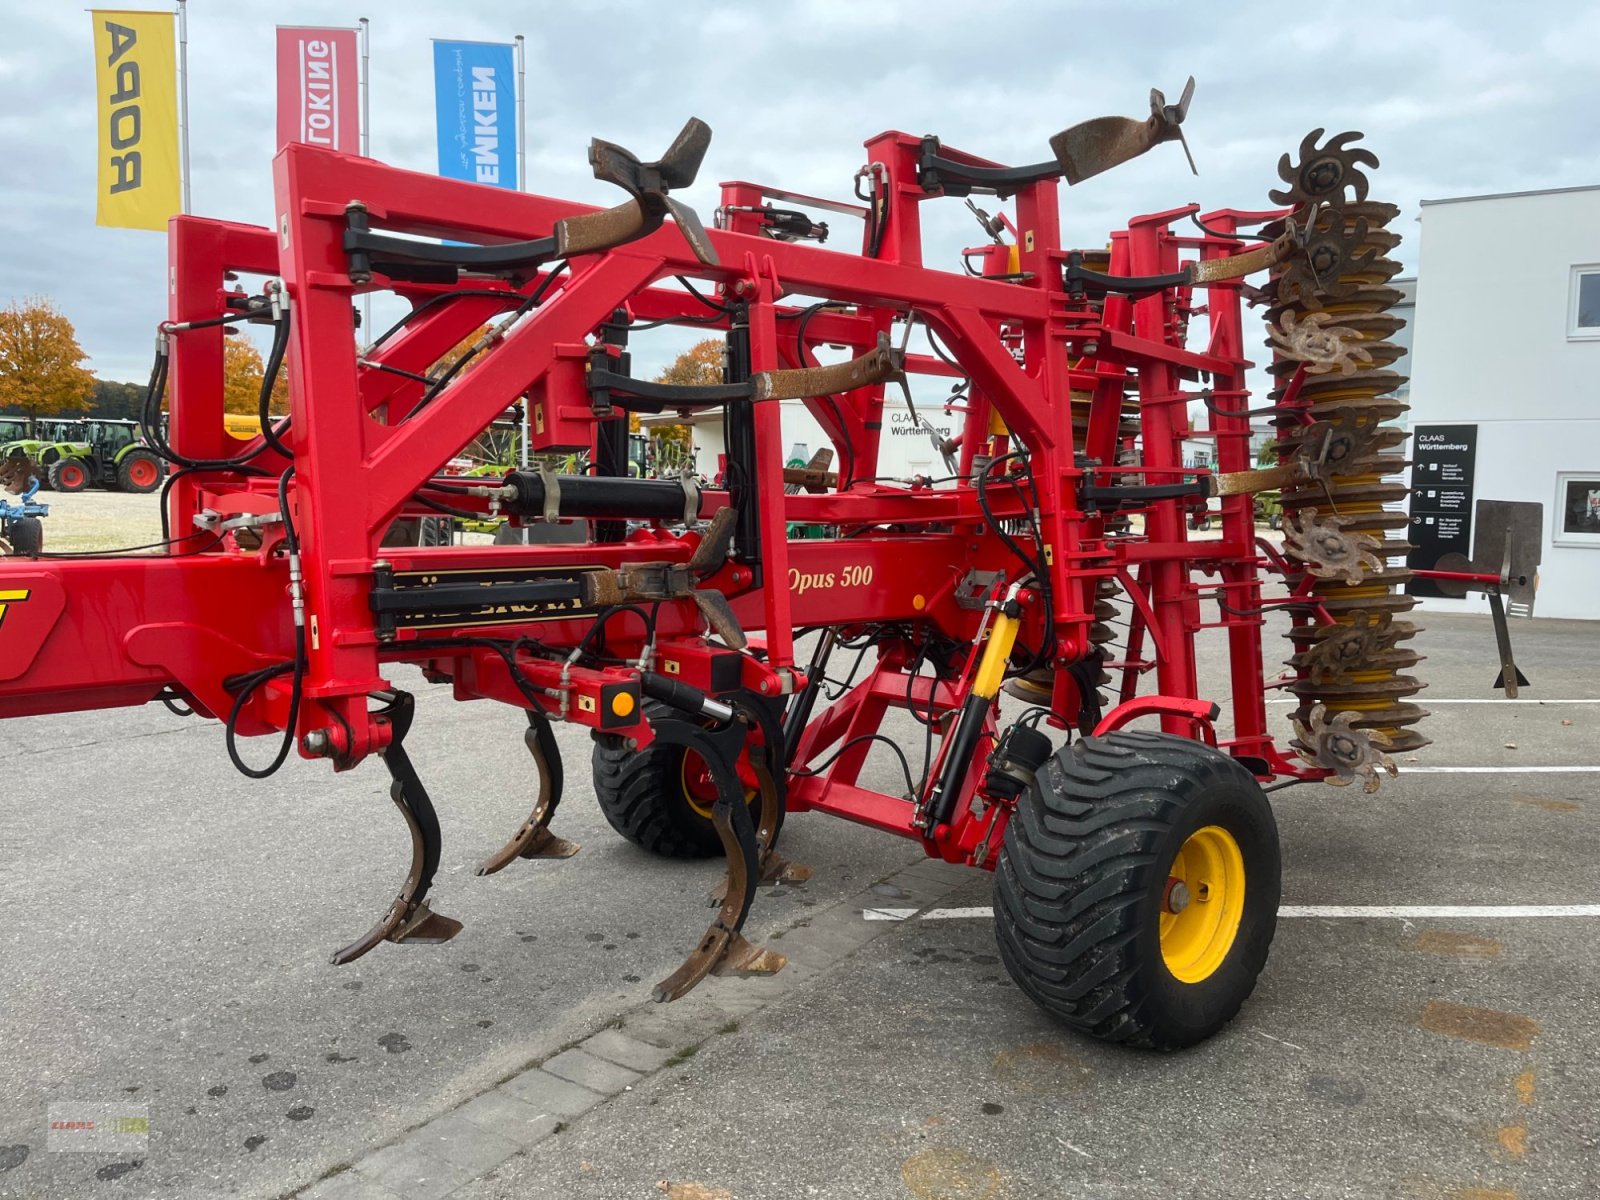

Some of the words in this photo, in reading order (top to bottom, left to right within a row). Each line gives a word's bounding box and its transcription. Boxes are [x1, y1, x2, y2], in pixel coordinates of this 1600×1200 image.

[1419, 434, 1445, 442] CLAAS
[1418, 443, 1469, 451] Württemberg
[788, 568, 836, 595] Opus
[840, 565, 873, 588] 500
